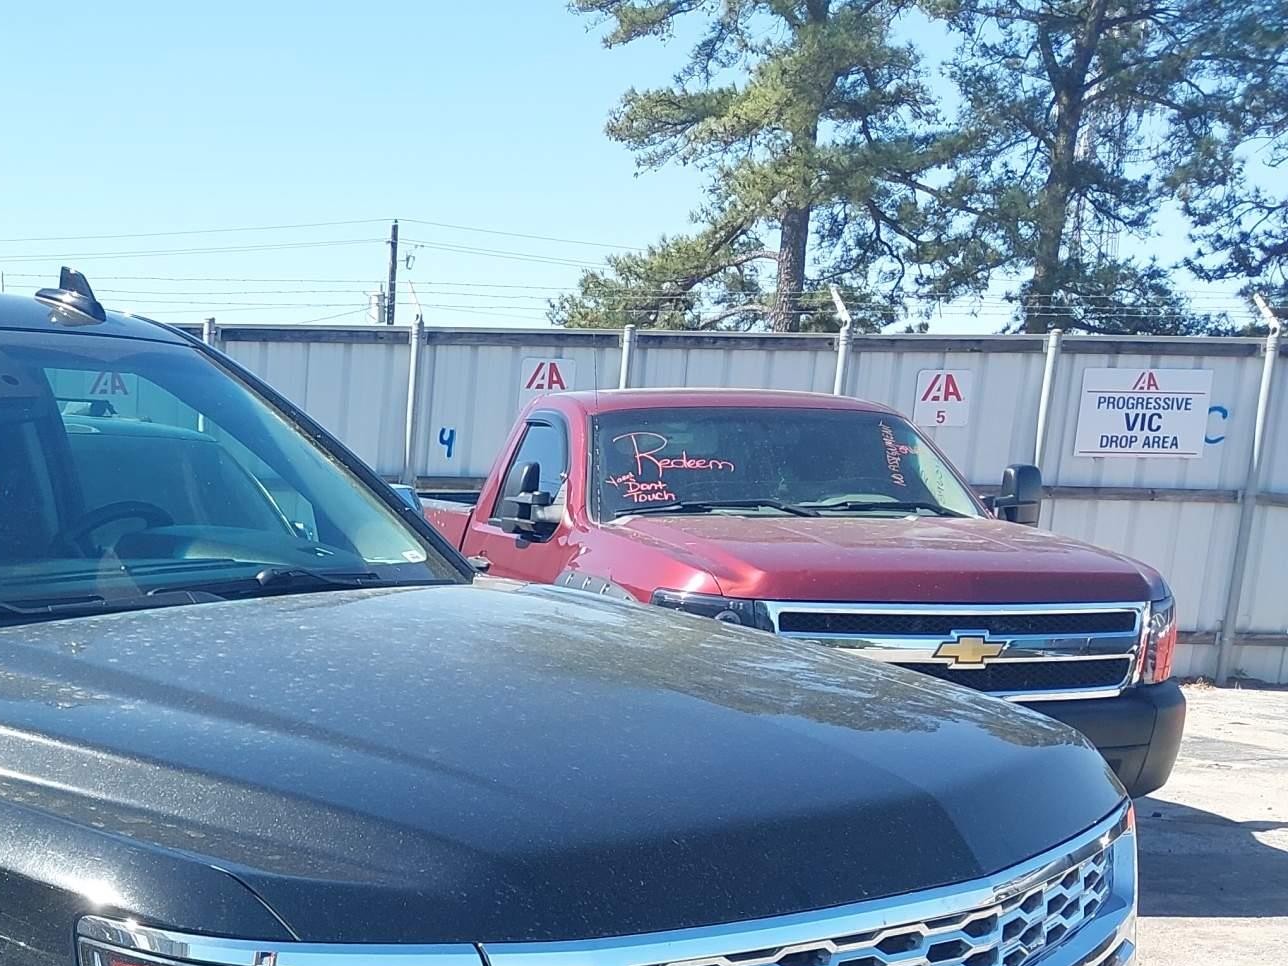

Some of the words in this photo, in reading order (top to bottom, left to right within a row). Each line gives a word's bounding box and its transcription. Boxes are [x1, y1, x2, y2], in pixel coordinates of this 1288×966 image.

[1097, 396, 1193, 411] PROGRESSIVE
[936, 410, 946, 424] 5
[1124, 412, 1163, 432] VIC
[439, 427, 456, 458] 4
[1099, 434, 1138, 449] DROP
[1141, 436, 1179, 450] AREA
[612, 431, 736, 479] Redeem
[623, 490, 676, 503] Touch
